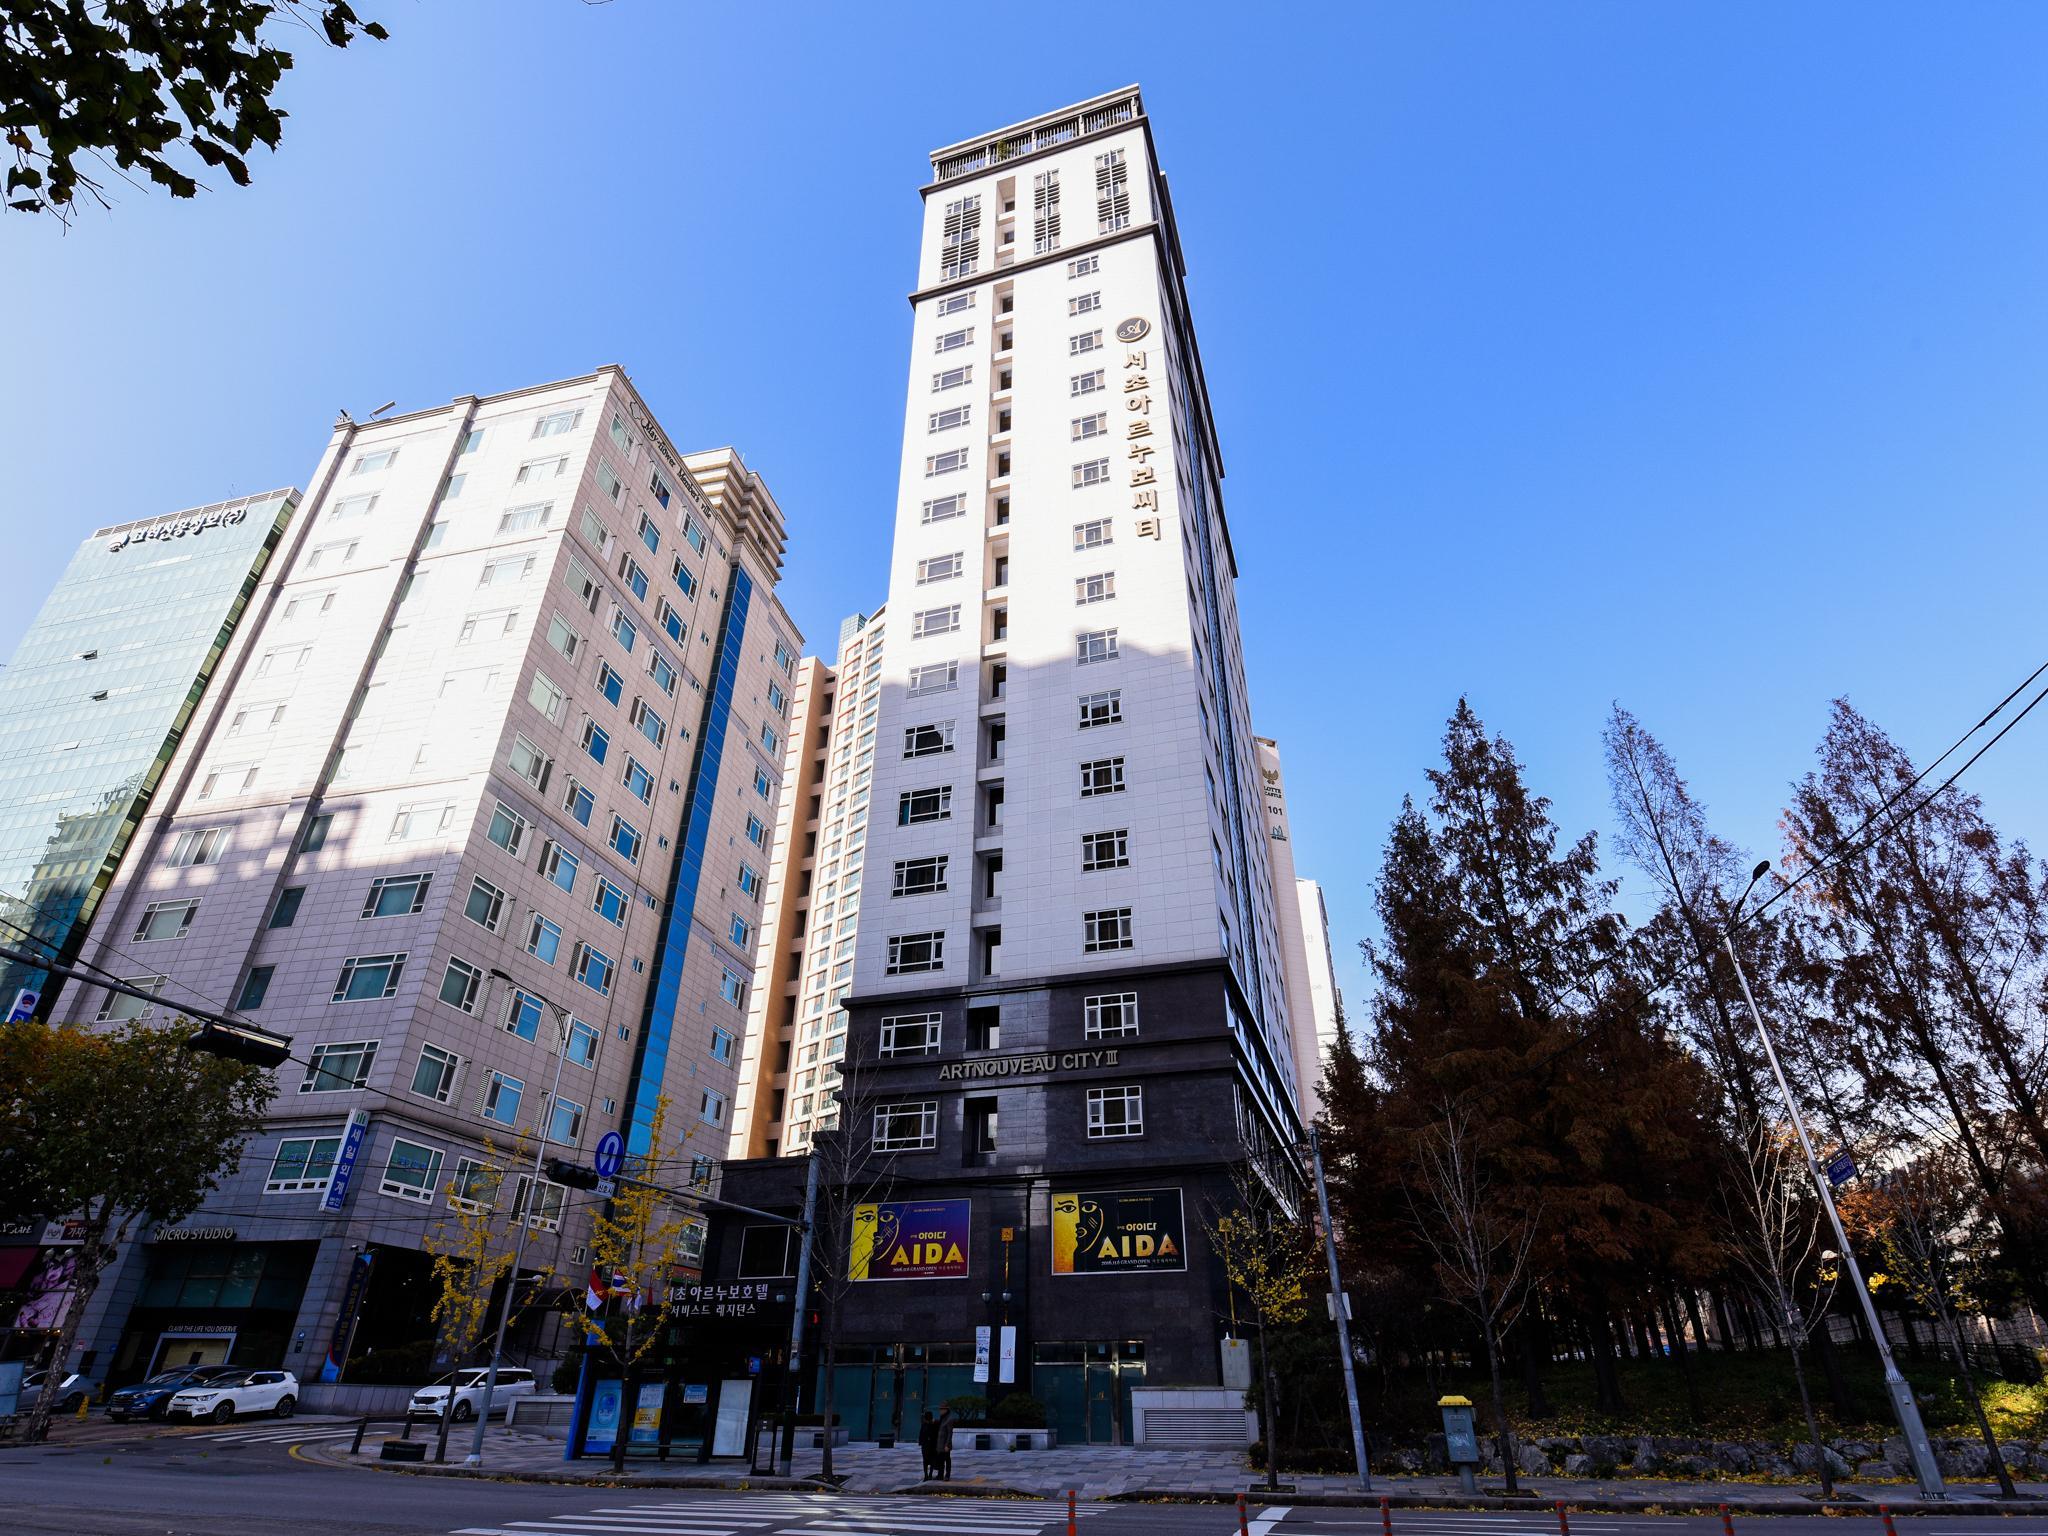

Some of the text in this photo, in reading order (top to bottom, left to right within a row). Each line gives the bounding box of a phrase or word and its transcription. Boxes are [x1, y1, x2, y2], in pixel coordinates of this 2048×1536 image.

[1267, 805, 1283, 816] 101
[939, 1055, 1057, 1080] ARTNOUVEAU
[1062, 1051, 1103, 1070] CITY
[1126, 1222, 1158, 1231] 아이다
[153, 1227, 234, 1241] MICRO STUDIO
[918, 1231, 947, 1240] 아이다
[1098, 1232, 1180, 1259] AIDA
[891, 1242, 965, 1266] AIDA
[671, 1303, 756, 1318] 서비스드 레지던스
[183, 1325, 193, 1333] THE
[204, 1325, 215, 1333] YOU
